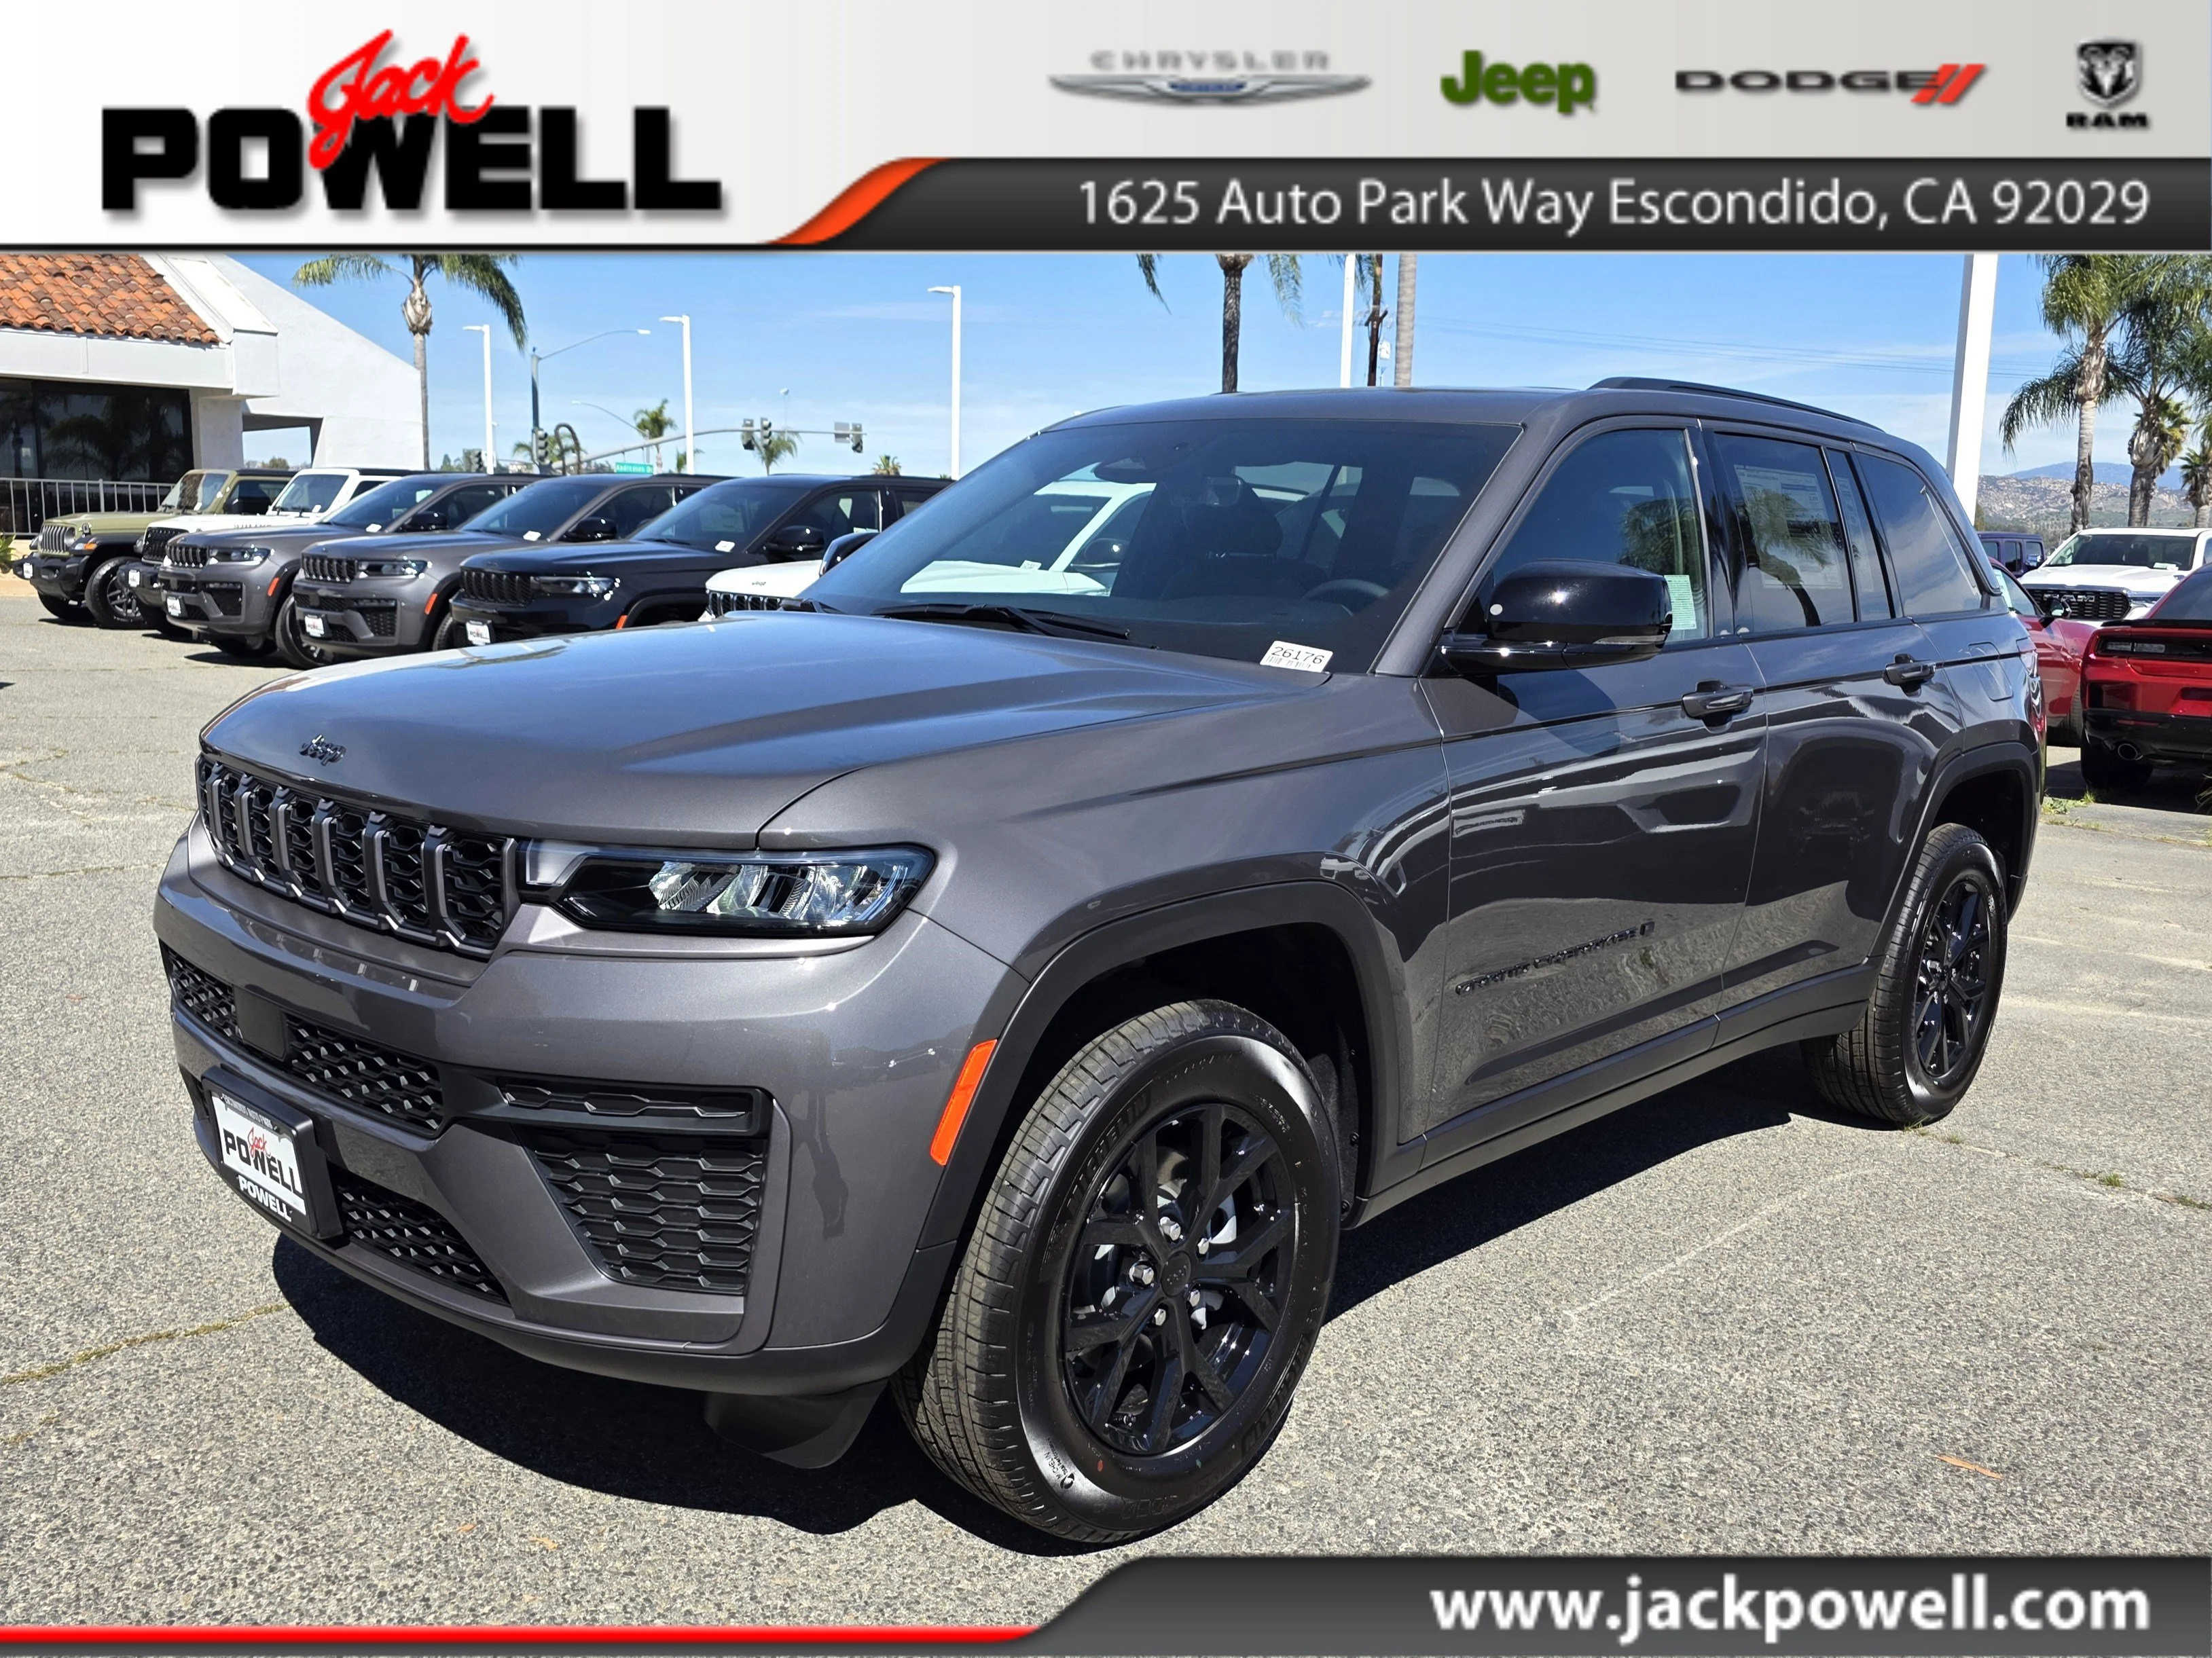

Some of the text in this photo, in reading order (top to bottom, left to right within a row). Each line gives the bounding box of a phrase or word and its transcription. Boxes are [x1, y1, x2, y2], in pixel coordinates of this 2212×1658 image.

[1271, 646, 1325, 665] 26176
[247, 1127, 271, 1158] Jack
[223, 1128, 304, 1200] POWELL
[238, 1175, 292, 1222] POWELL
